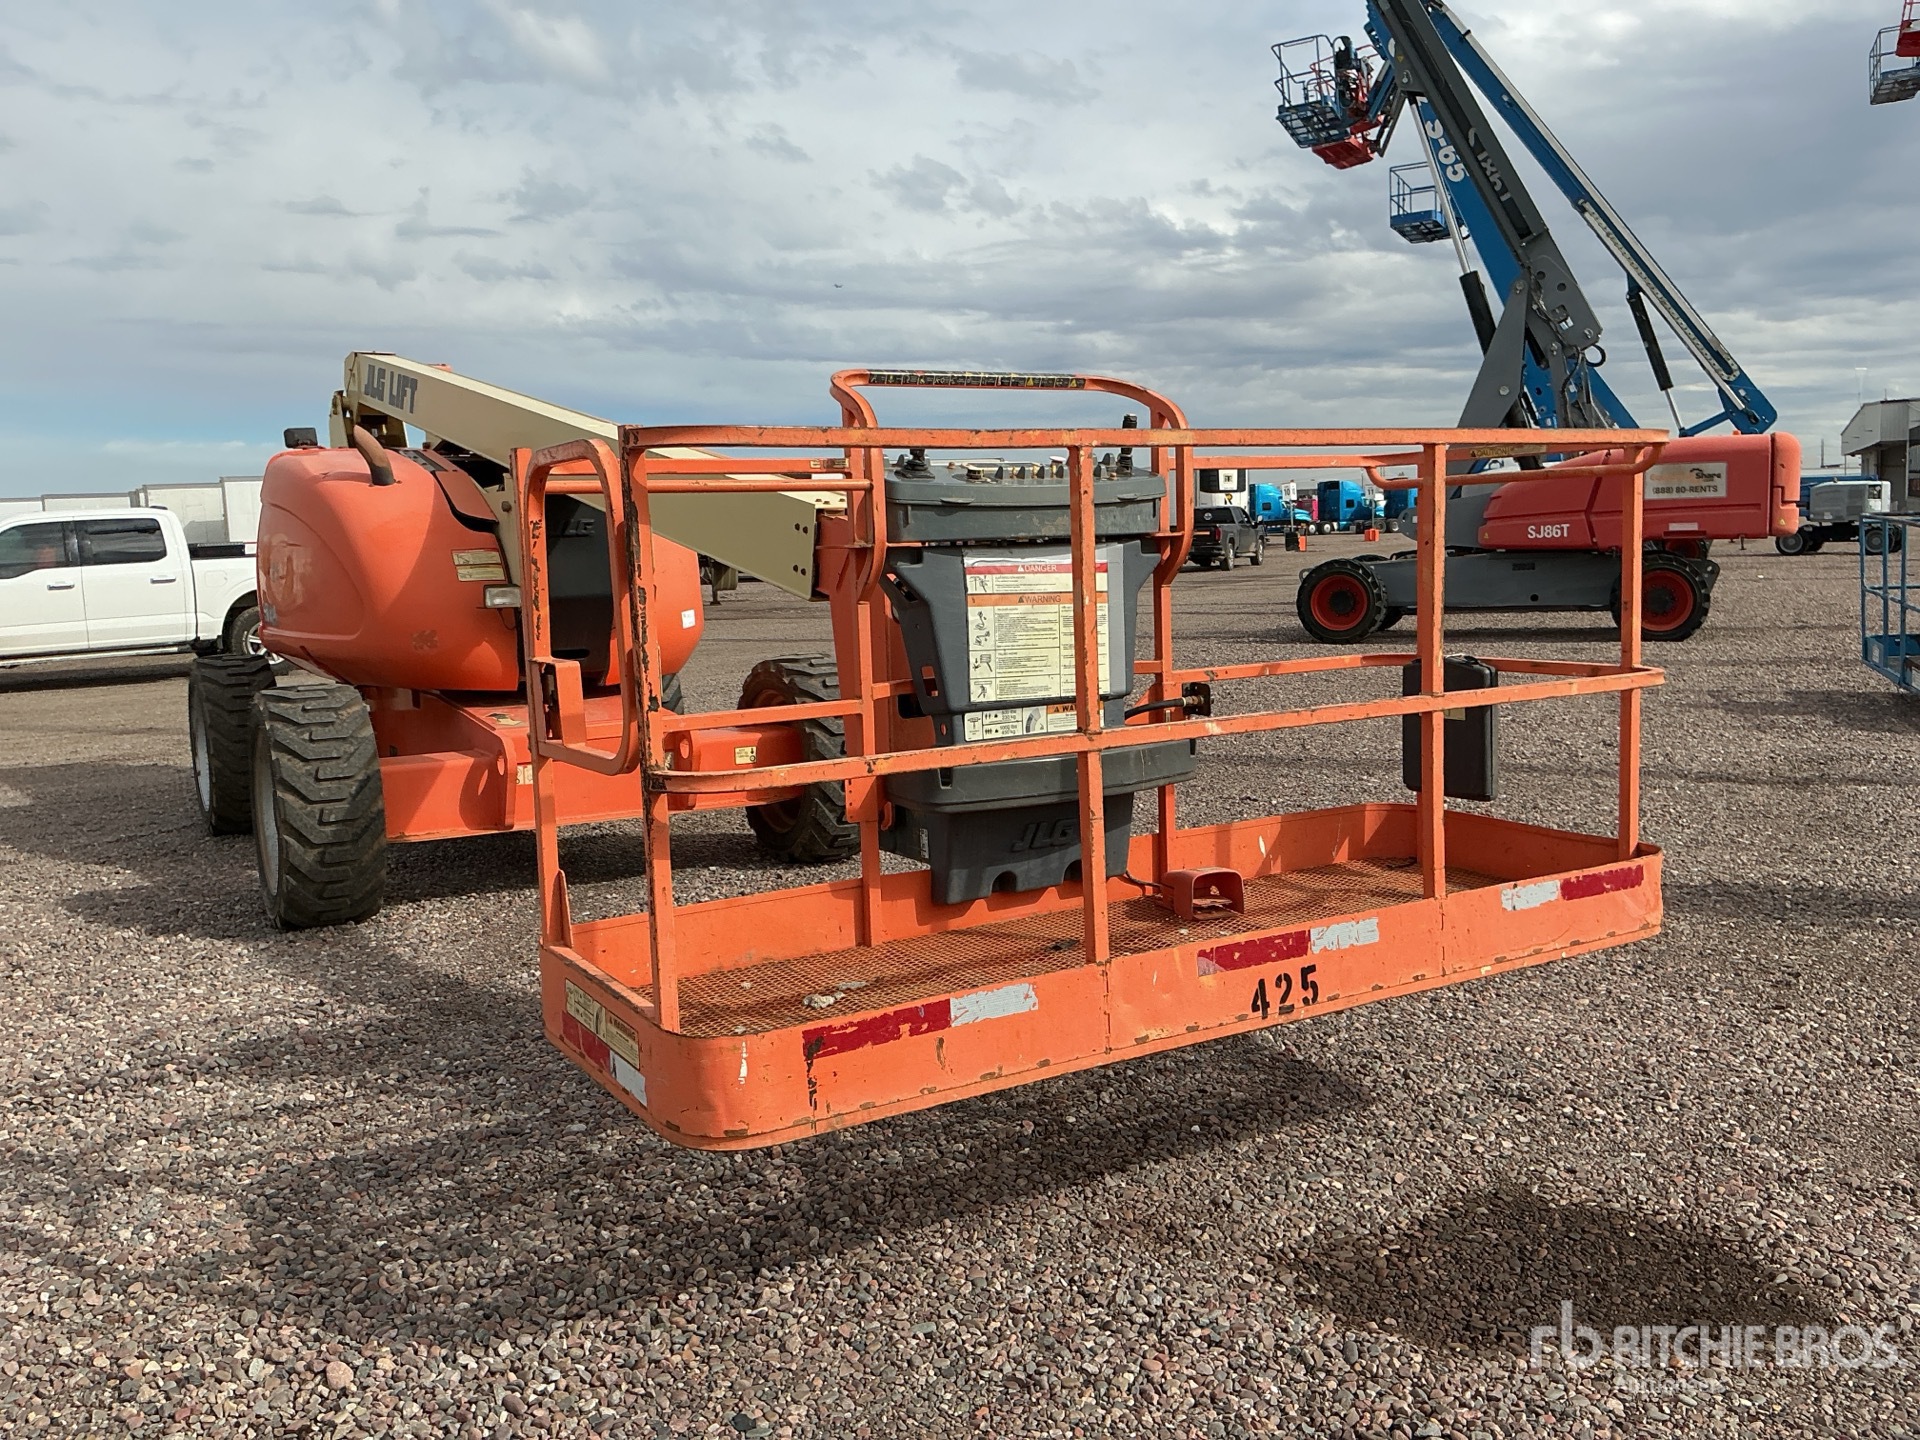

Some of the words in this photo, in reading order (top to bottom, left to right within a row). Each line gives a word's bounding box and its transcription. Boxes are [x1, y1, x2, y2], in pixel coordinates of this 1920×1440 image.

[364, 364, 386, 402] JLG
[388, 371, 418, 414] LIFT
[1527, 523, 1570, 539] SJ86T
[1024, 564, 1057, 572] DANGER
[1024, 594, 1062, 604] WARNING
[1011, 817, 1077, 852] JLG
[1251, 964, 1319, 1020] 425
